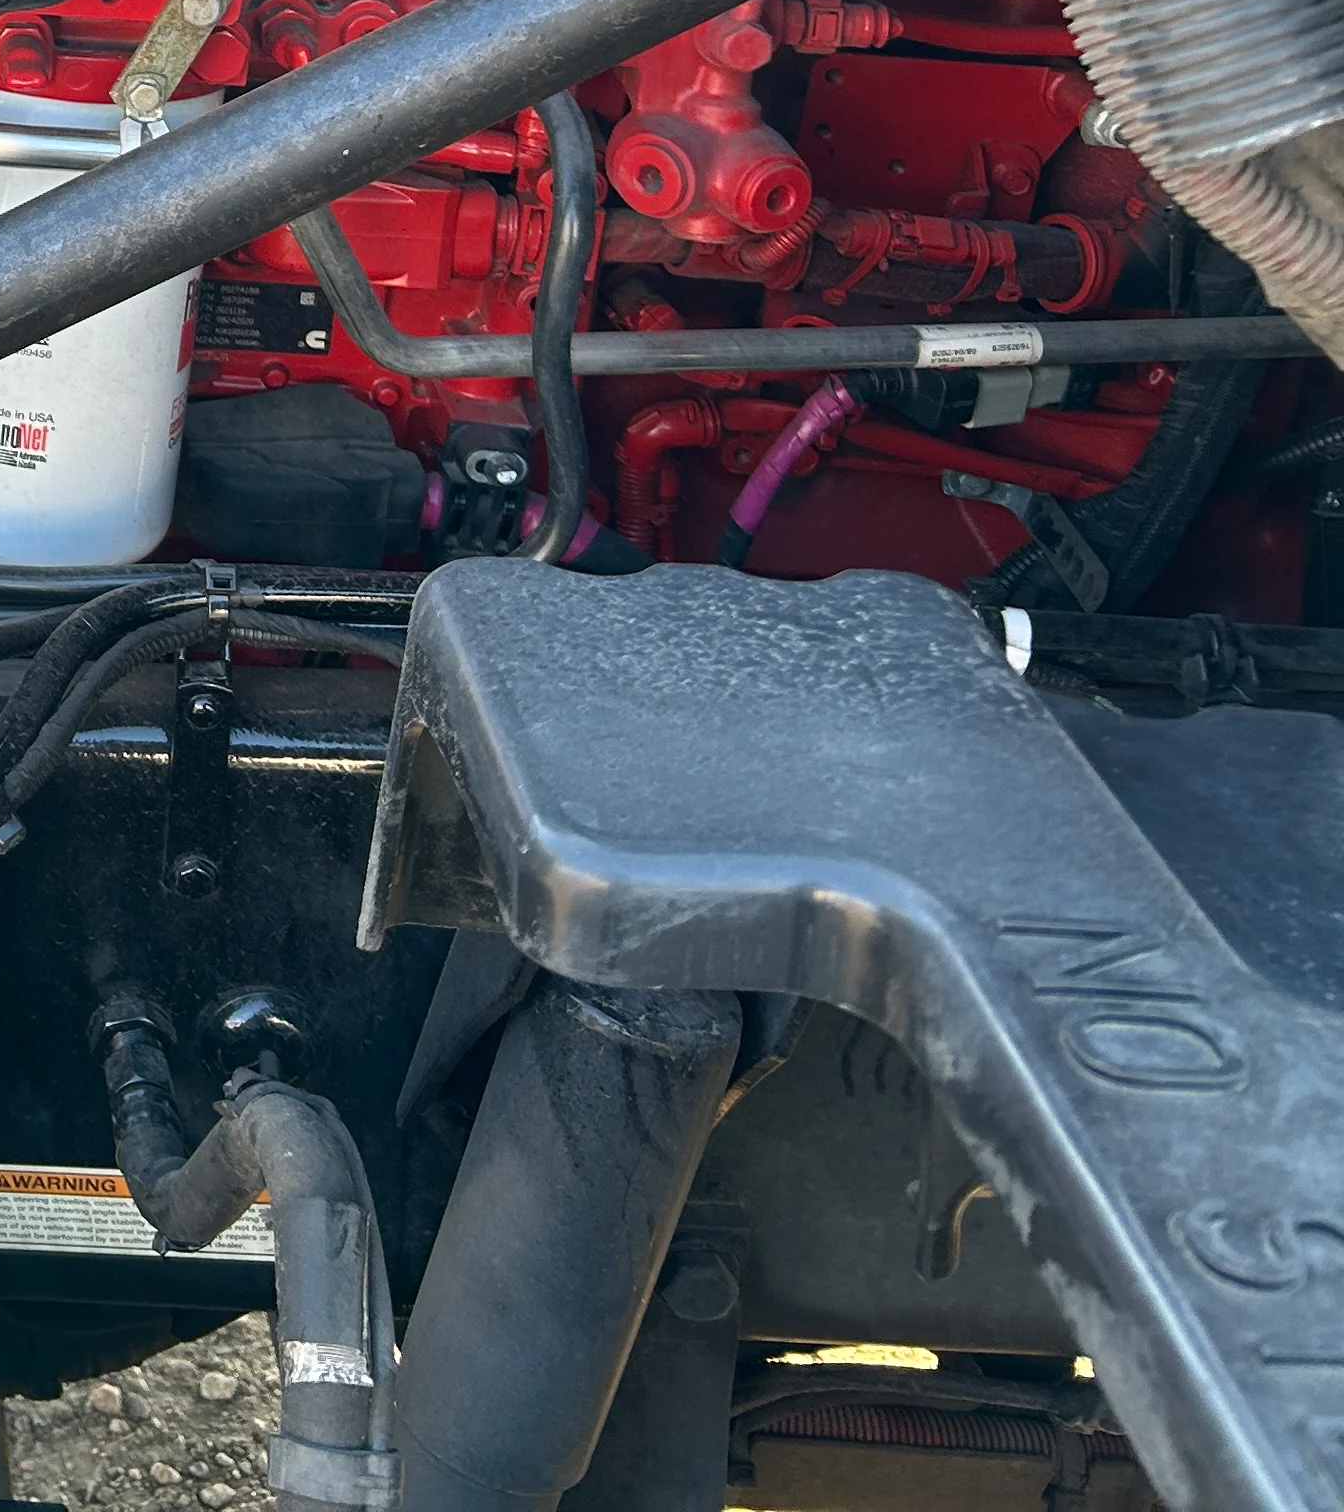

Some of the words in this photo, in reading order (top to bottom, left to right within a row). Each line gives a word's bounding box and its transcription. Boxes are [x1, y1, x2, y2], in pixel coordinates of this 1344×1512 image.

[15, 408, 25, 420] in
[28, 411, 55, 424] USA
[13, 1174, 117, 1193] WARNING
[13, 1196, 50, 1205] steering
[53, 1207, 90, 1216] steering
[45, 1215, 92, 1224] performed
[43, 1224, 74, 1232] vehicle
[95, 1227, 134, 1235] personal
[47, 1234, 94, 1242] performed
